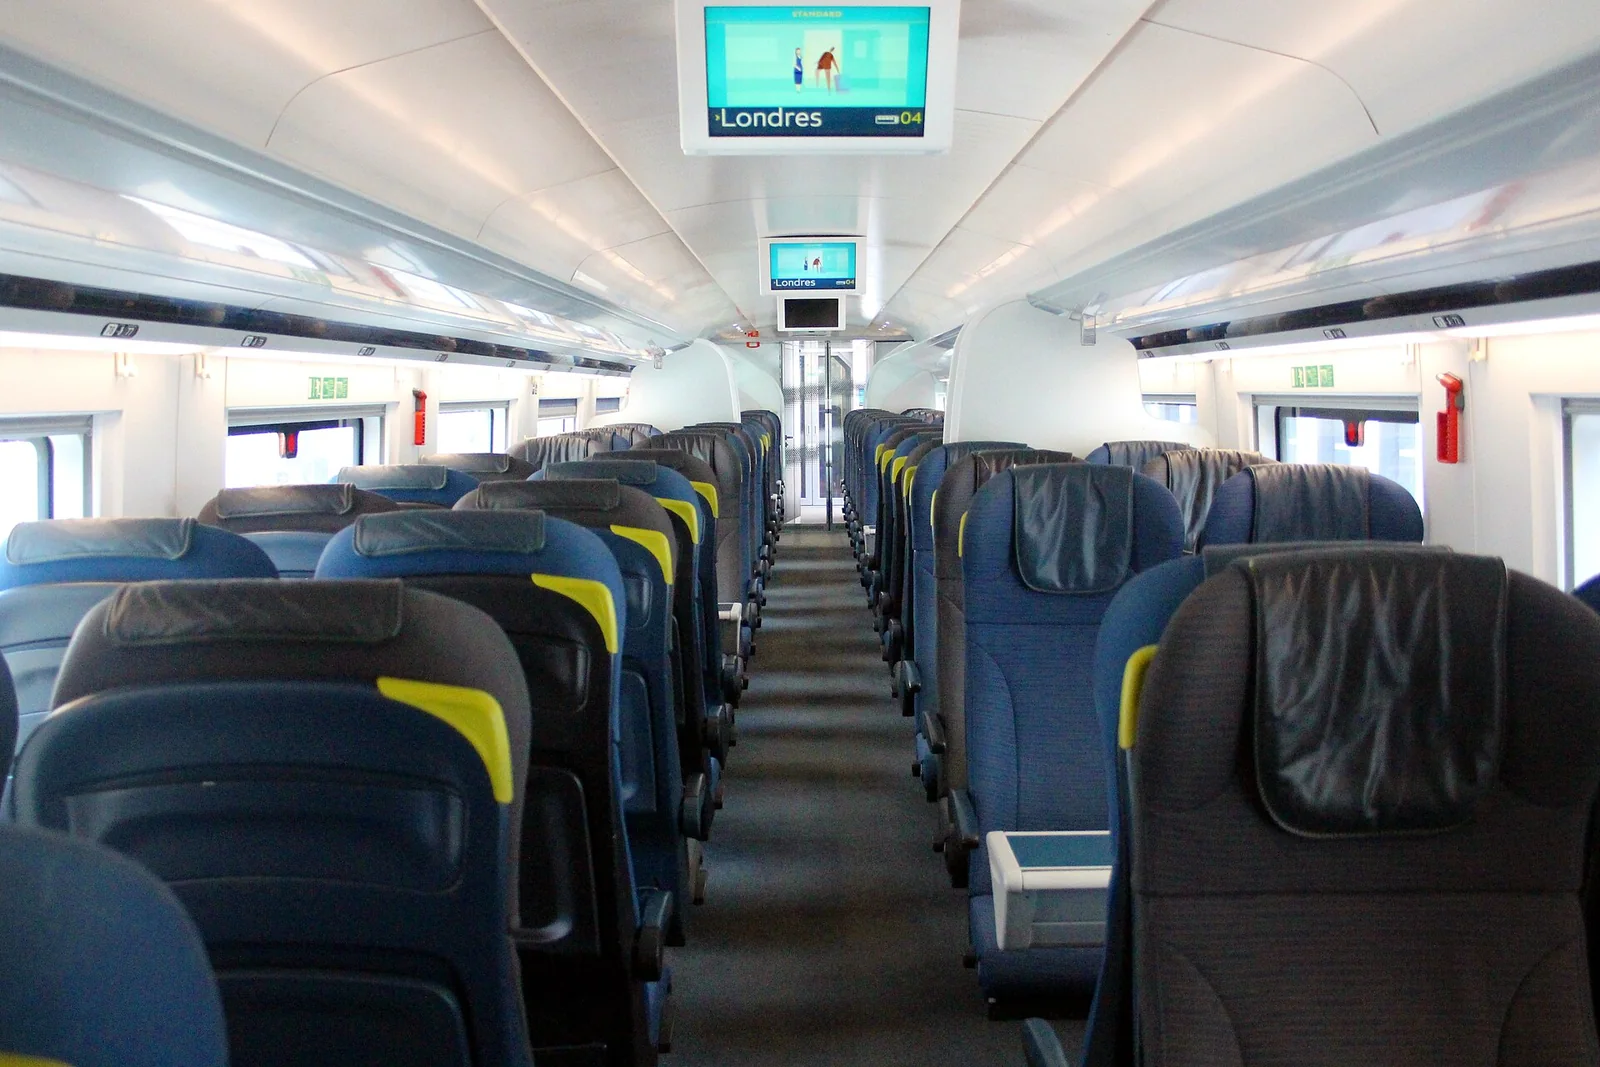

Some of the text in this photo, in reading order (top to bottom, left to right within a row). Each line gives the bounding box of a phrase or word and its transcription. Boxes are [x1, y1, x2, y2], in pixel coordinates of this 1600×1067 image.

[721, 107, 922, 128] Londres 04
[775, 278, 816, 287] Londres
